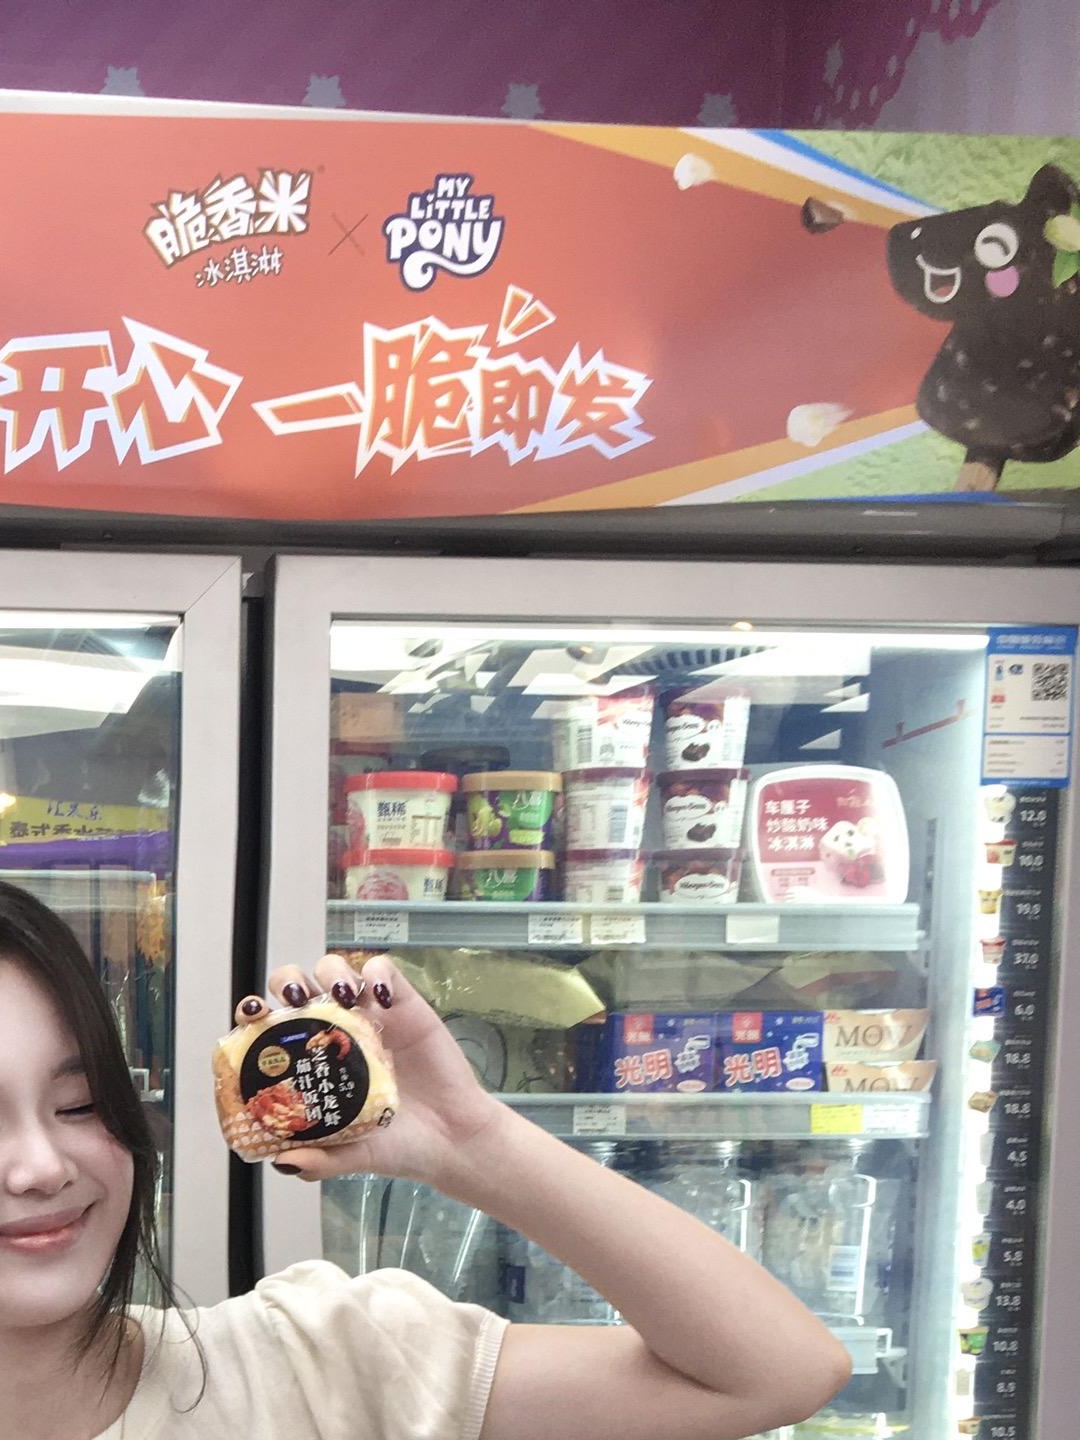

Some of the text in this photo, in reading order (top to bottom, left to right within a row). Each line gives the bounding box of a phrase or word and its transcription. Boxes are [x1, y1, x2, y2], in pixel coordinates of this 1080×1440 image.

[436, 177, 468, 198] MY
[145, 168, 313, 268] 脆香米
[195, 247, 283, 287] 冰淇淋
[615, 1048, 672, 1088] 光明
[724, 1046, 783, 1088] 光明
